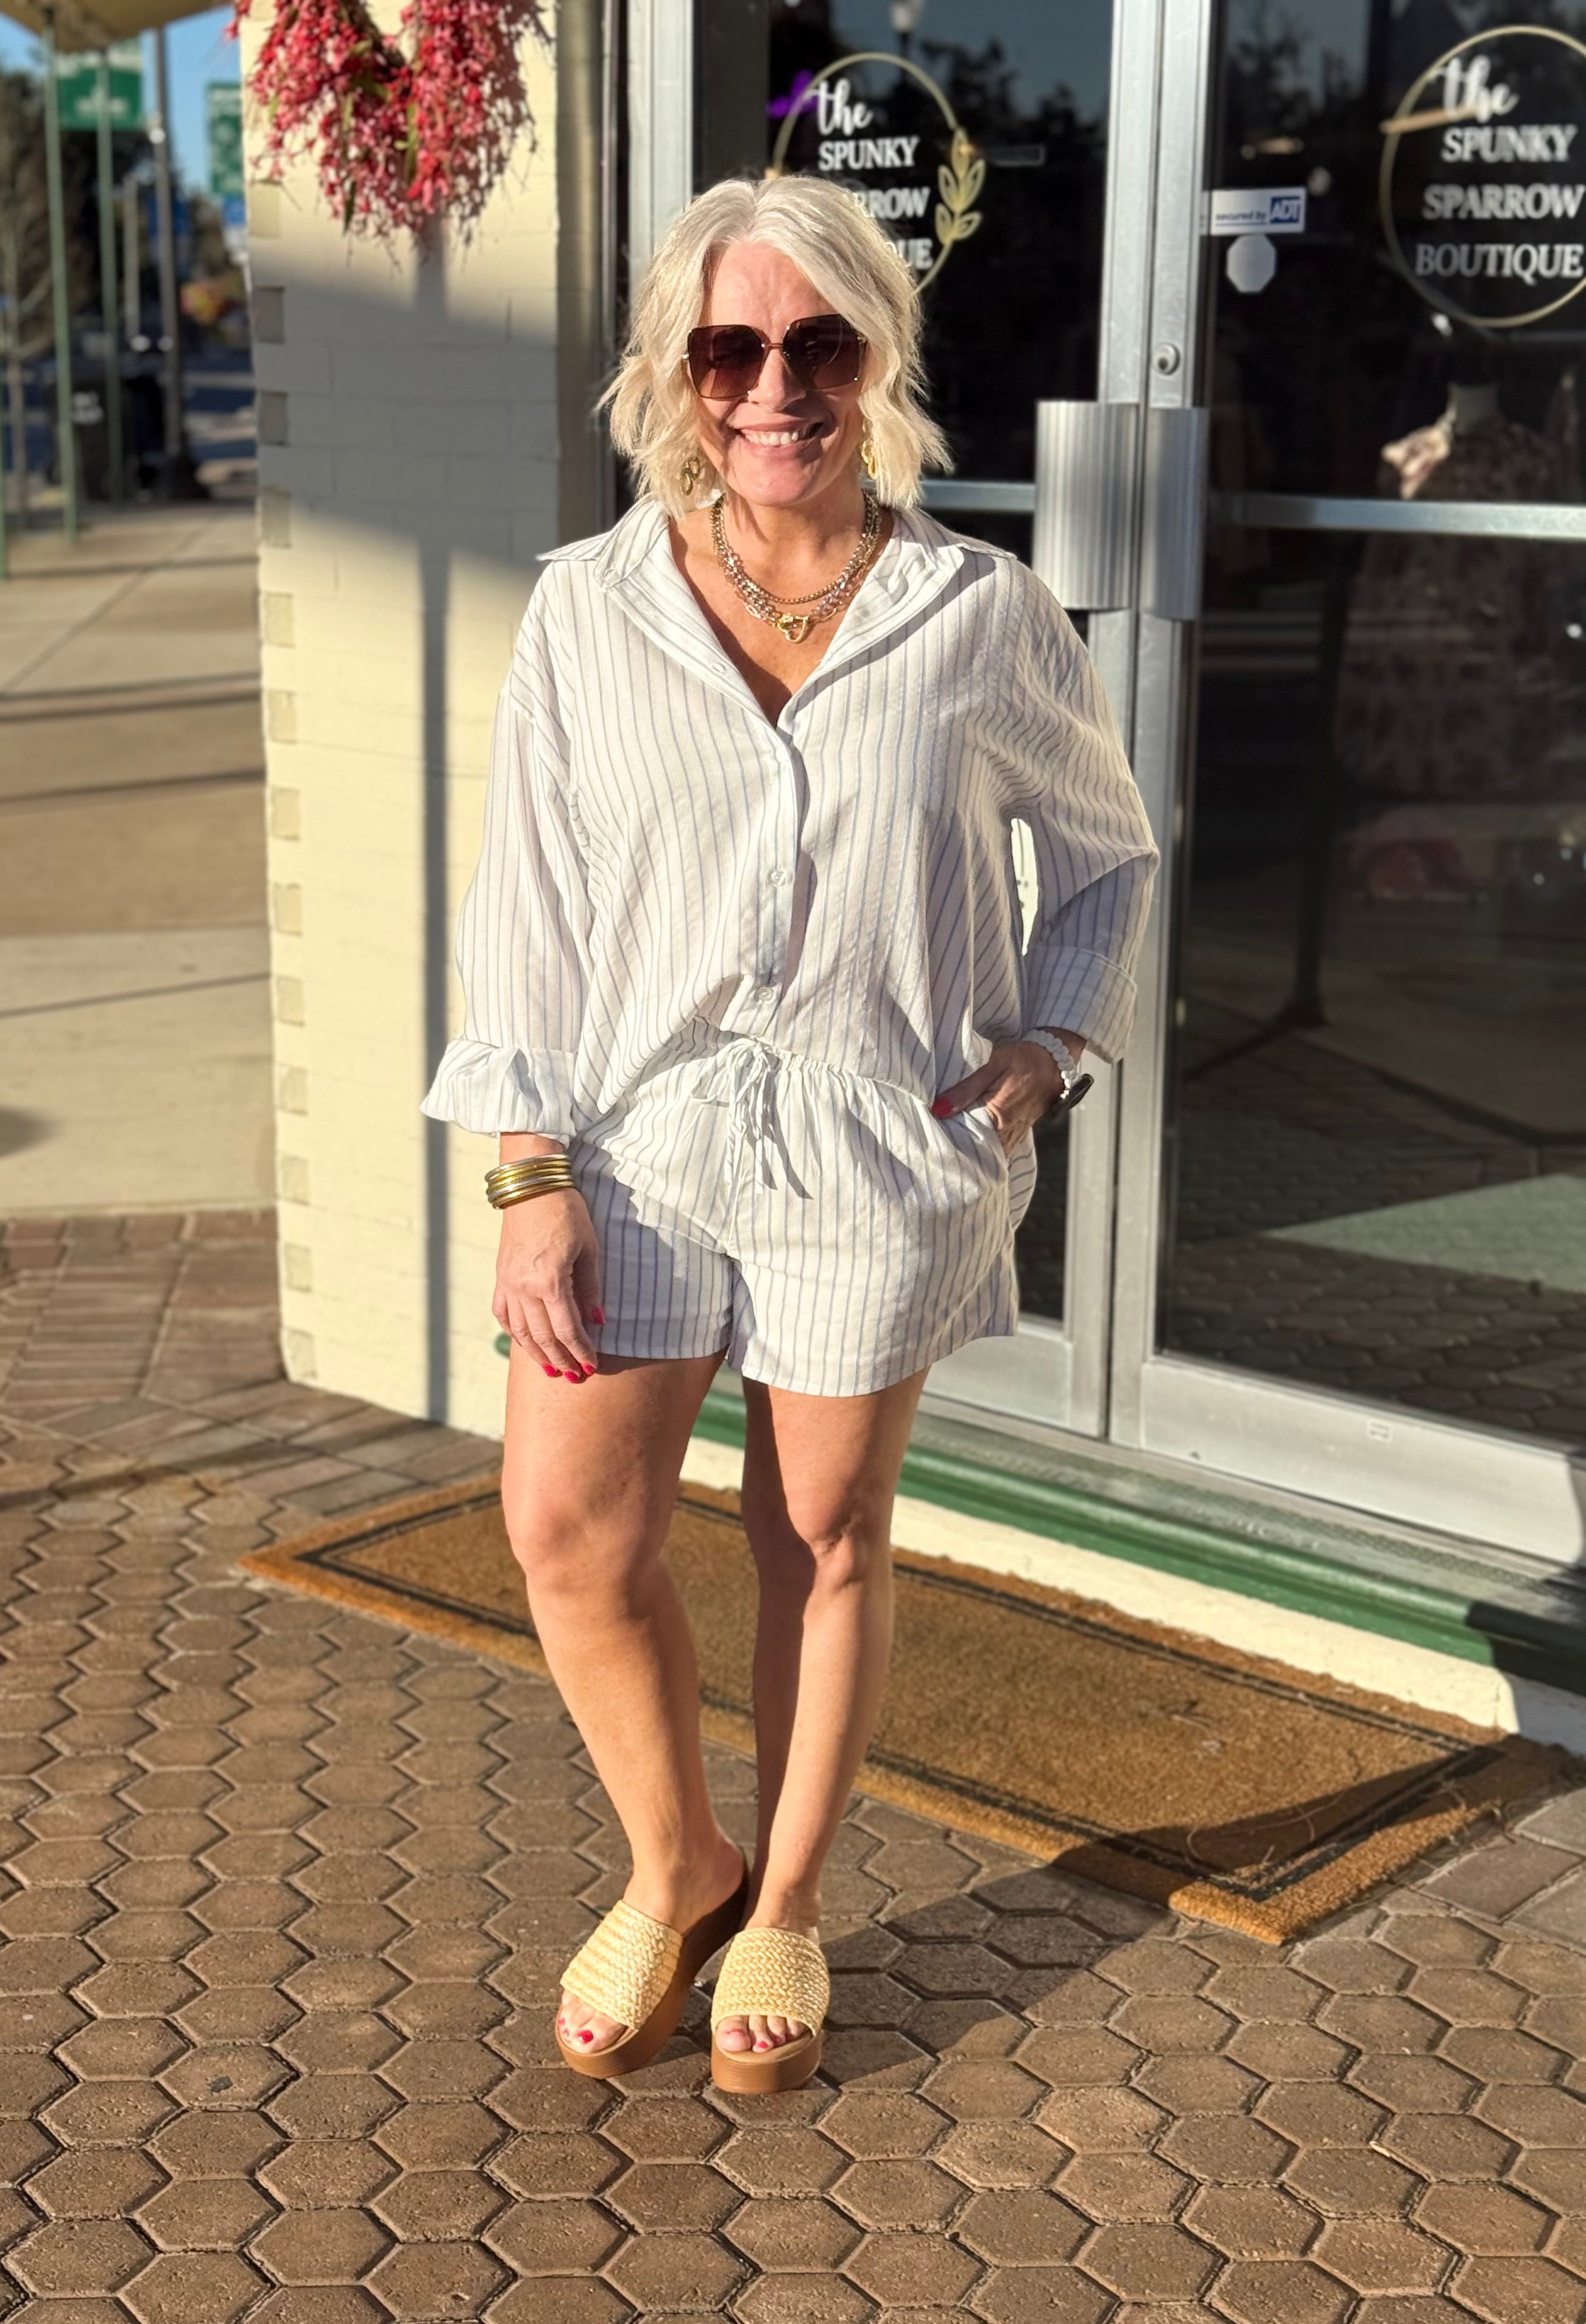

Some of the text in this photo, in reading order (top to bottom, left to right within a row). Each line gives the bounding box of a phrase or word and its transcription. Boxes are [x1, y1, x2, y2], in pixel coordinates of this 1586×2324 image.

[808, 79, 873, 136] the
[1434, 55, 1519, 122] the
[819, 135, 920, 171] SPUNKY
[1442, 124, 1578, 163] SPUNKY
[1216, 199, 1299, 223] secured by ADT
[1422, 183, 1586, 219] SPARROW
[1415, 244, 1585, 286] BOUTIQUE
